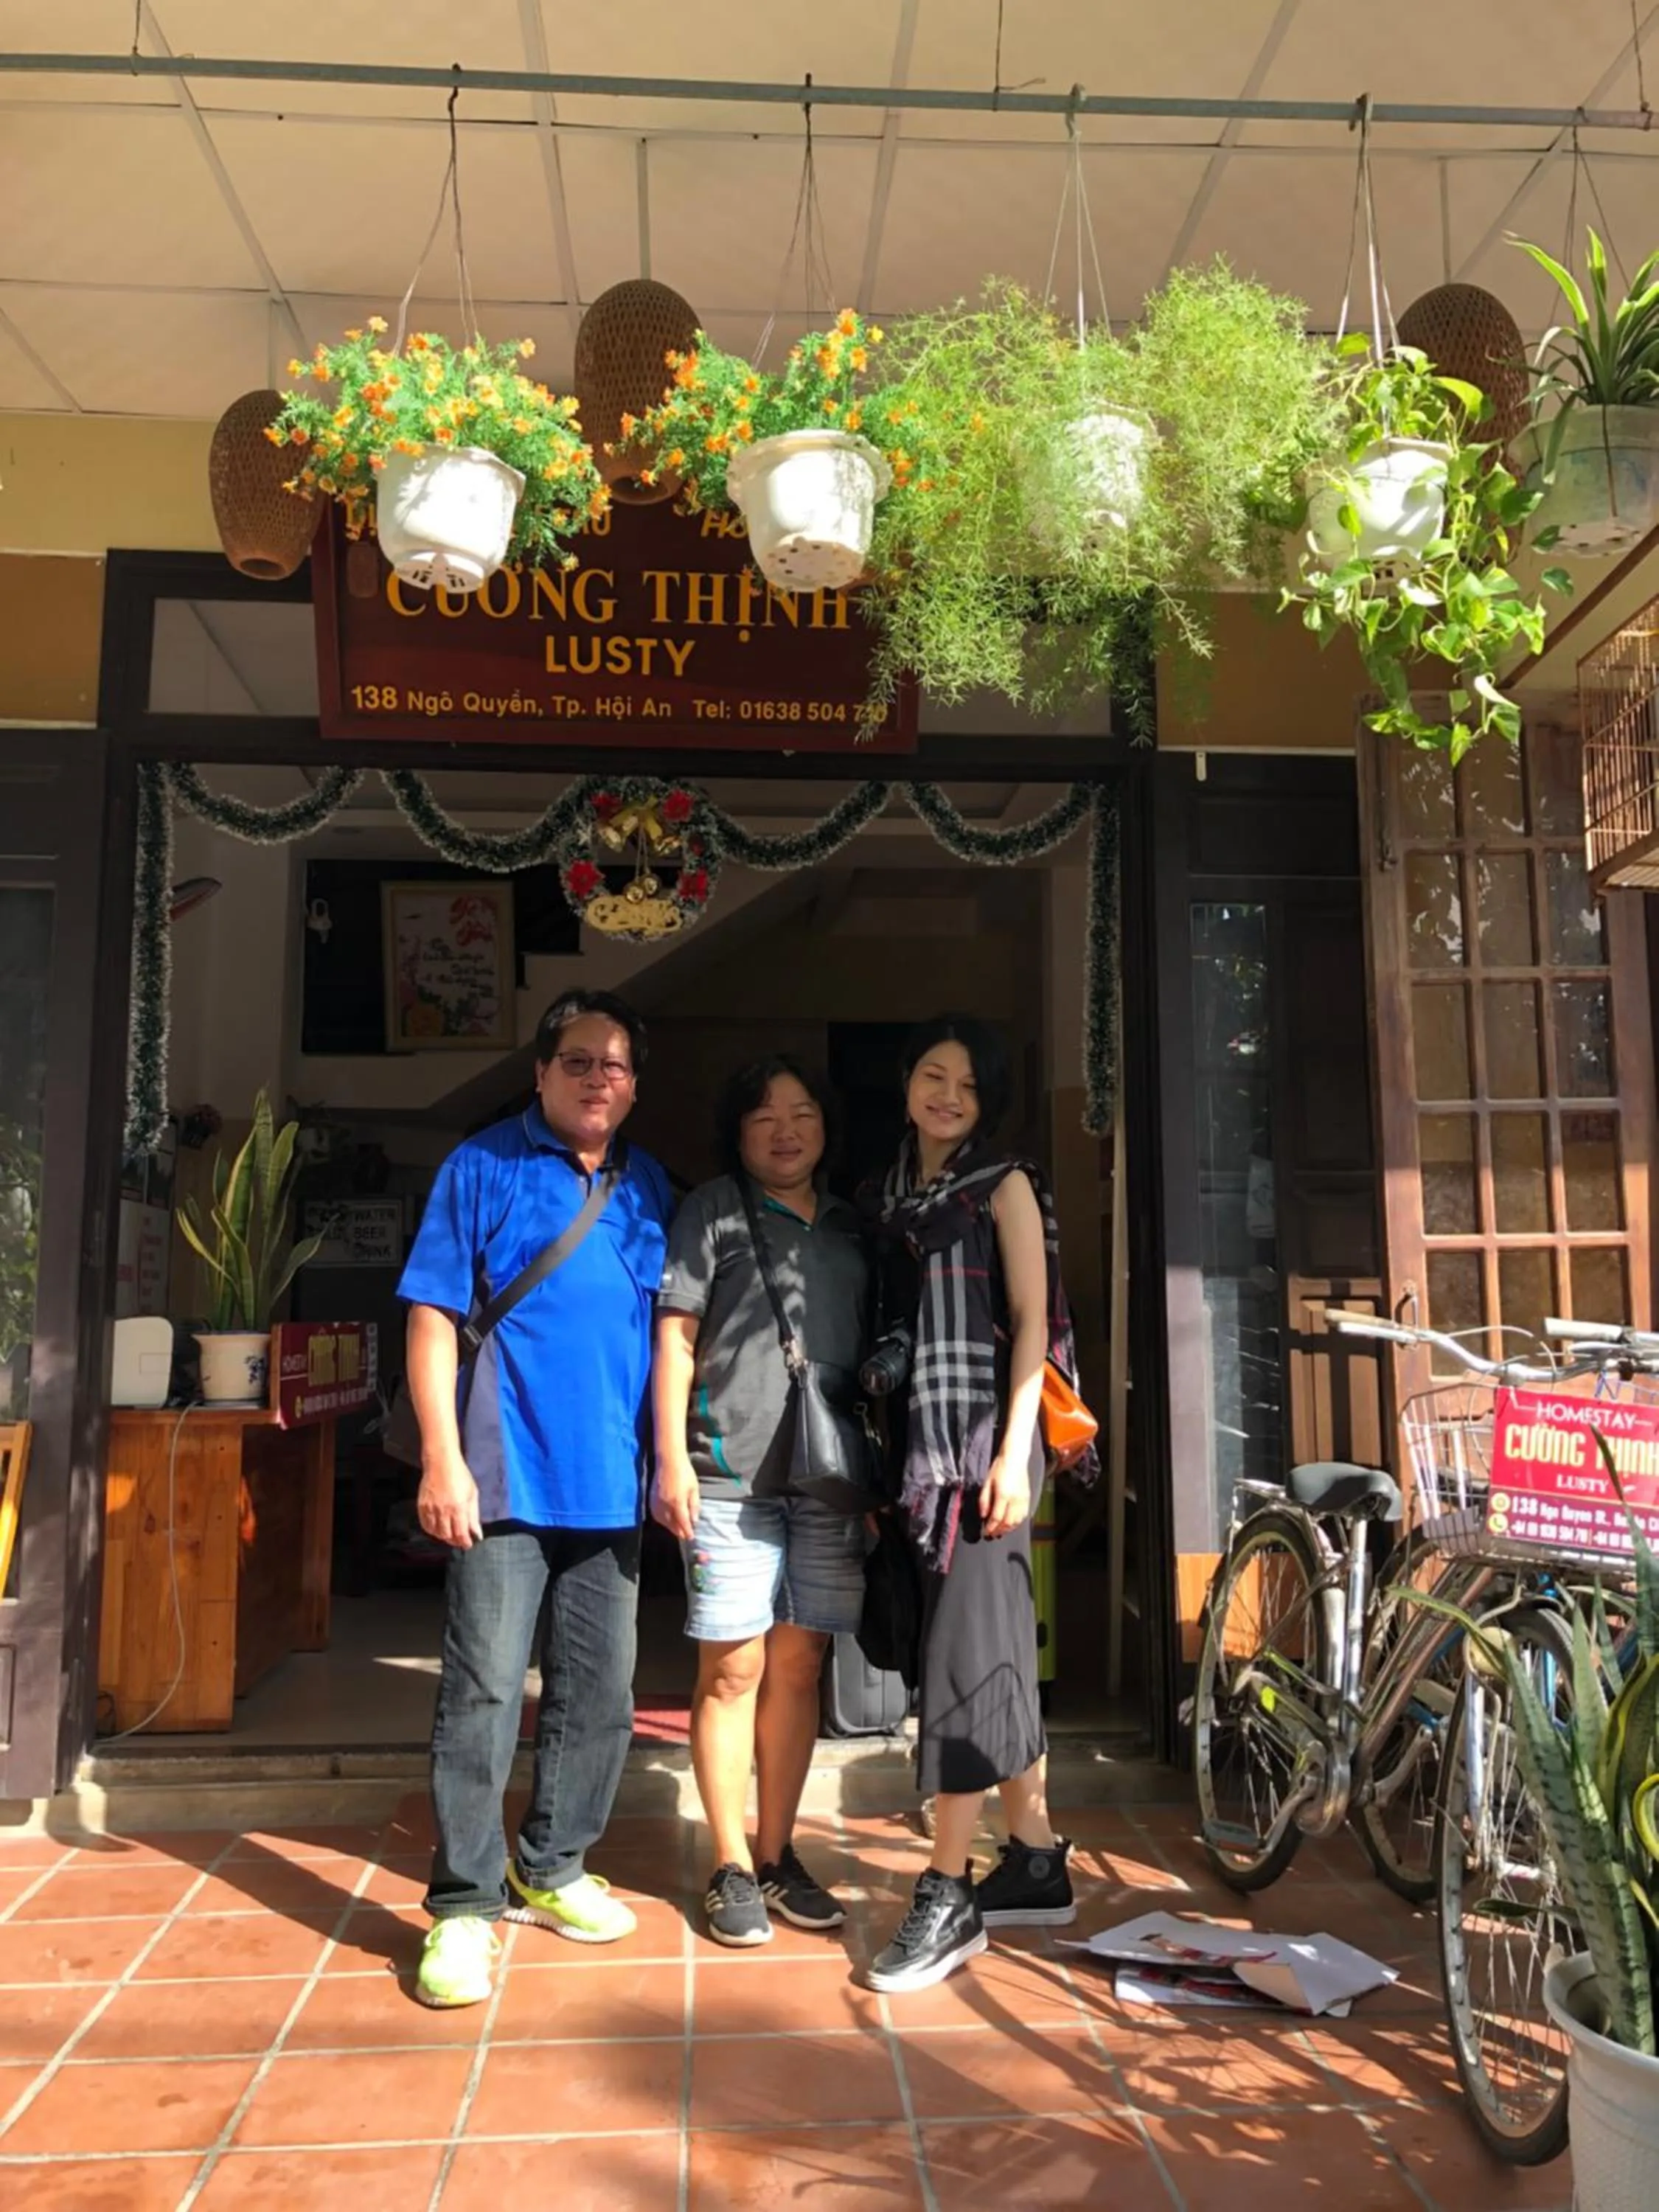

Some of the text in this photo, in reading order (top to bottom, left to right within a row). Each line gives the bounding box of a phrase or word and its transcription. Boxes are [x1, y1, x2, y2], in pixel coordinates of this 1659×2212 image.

[546, 635, 696, 677] LUSTY
[351, 685, 398, 710] 138
[407, 690, 454, 717] Ngô
[552, 695, 587, 719] Tp.
[595, 696, 632, 721] Hội
[641, 698, 672, 717] An
[693, 699, 731, 720] Tel:
[740, 700, 801, 721] 01638
[806, 702, 846, 722] 504
[1536, 1402, 1636, 1430] HOMESTAY
[1557, 1474, 1610, 1494] LUSTY
[1512, 1495, 1539, 1516] 138
